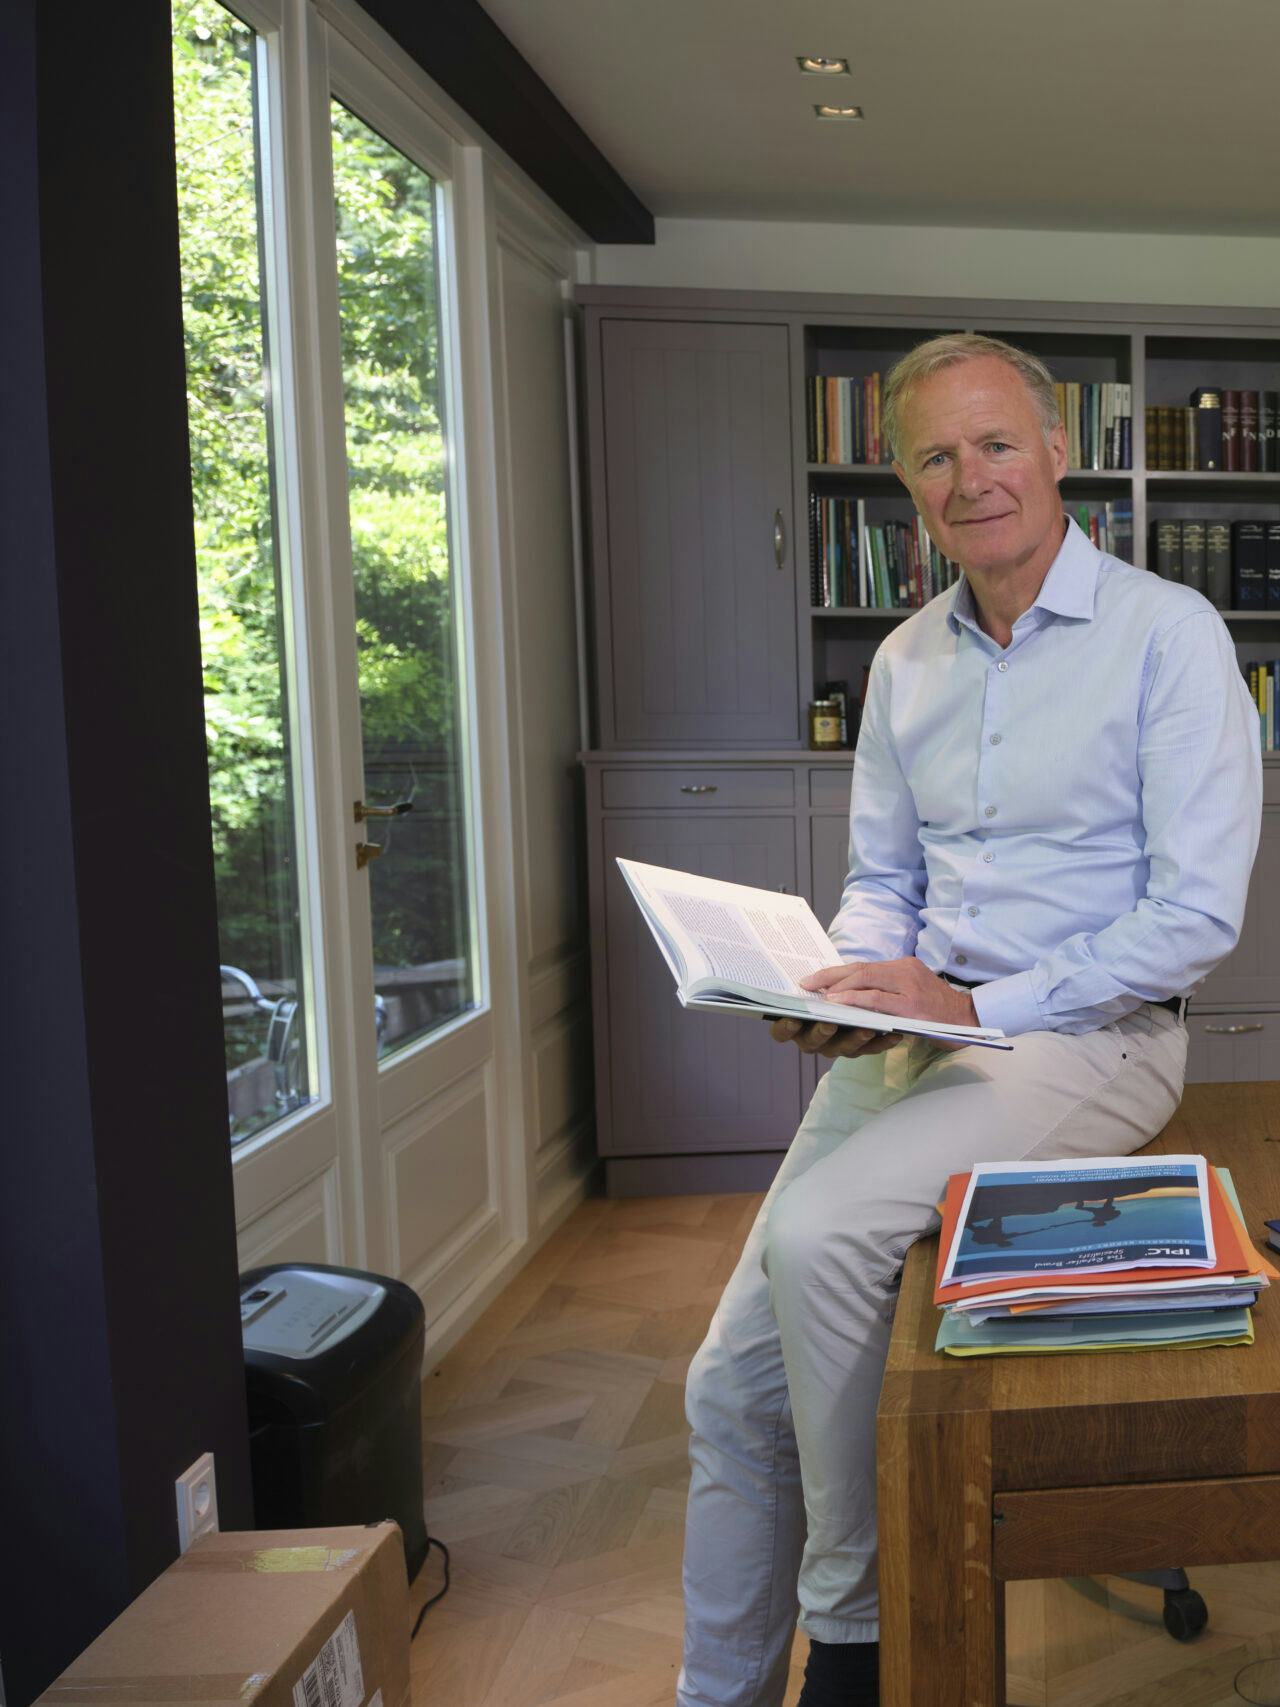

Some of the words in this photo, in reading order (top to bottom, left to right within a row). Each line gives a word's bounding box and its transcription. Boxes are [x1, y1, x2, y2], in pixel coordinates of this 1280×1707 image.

[1078, 1248, 1125, 1260] Specialists
[1146, 1247, 1190, 1256] IPLC
[1034, 1261, 1063, 1269] Brand
[1066, 1257, 1104, 1265] Retailer
